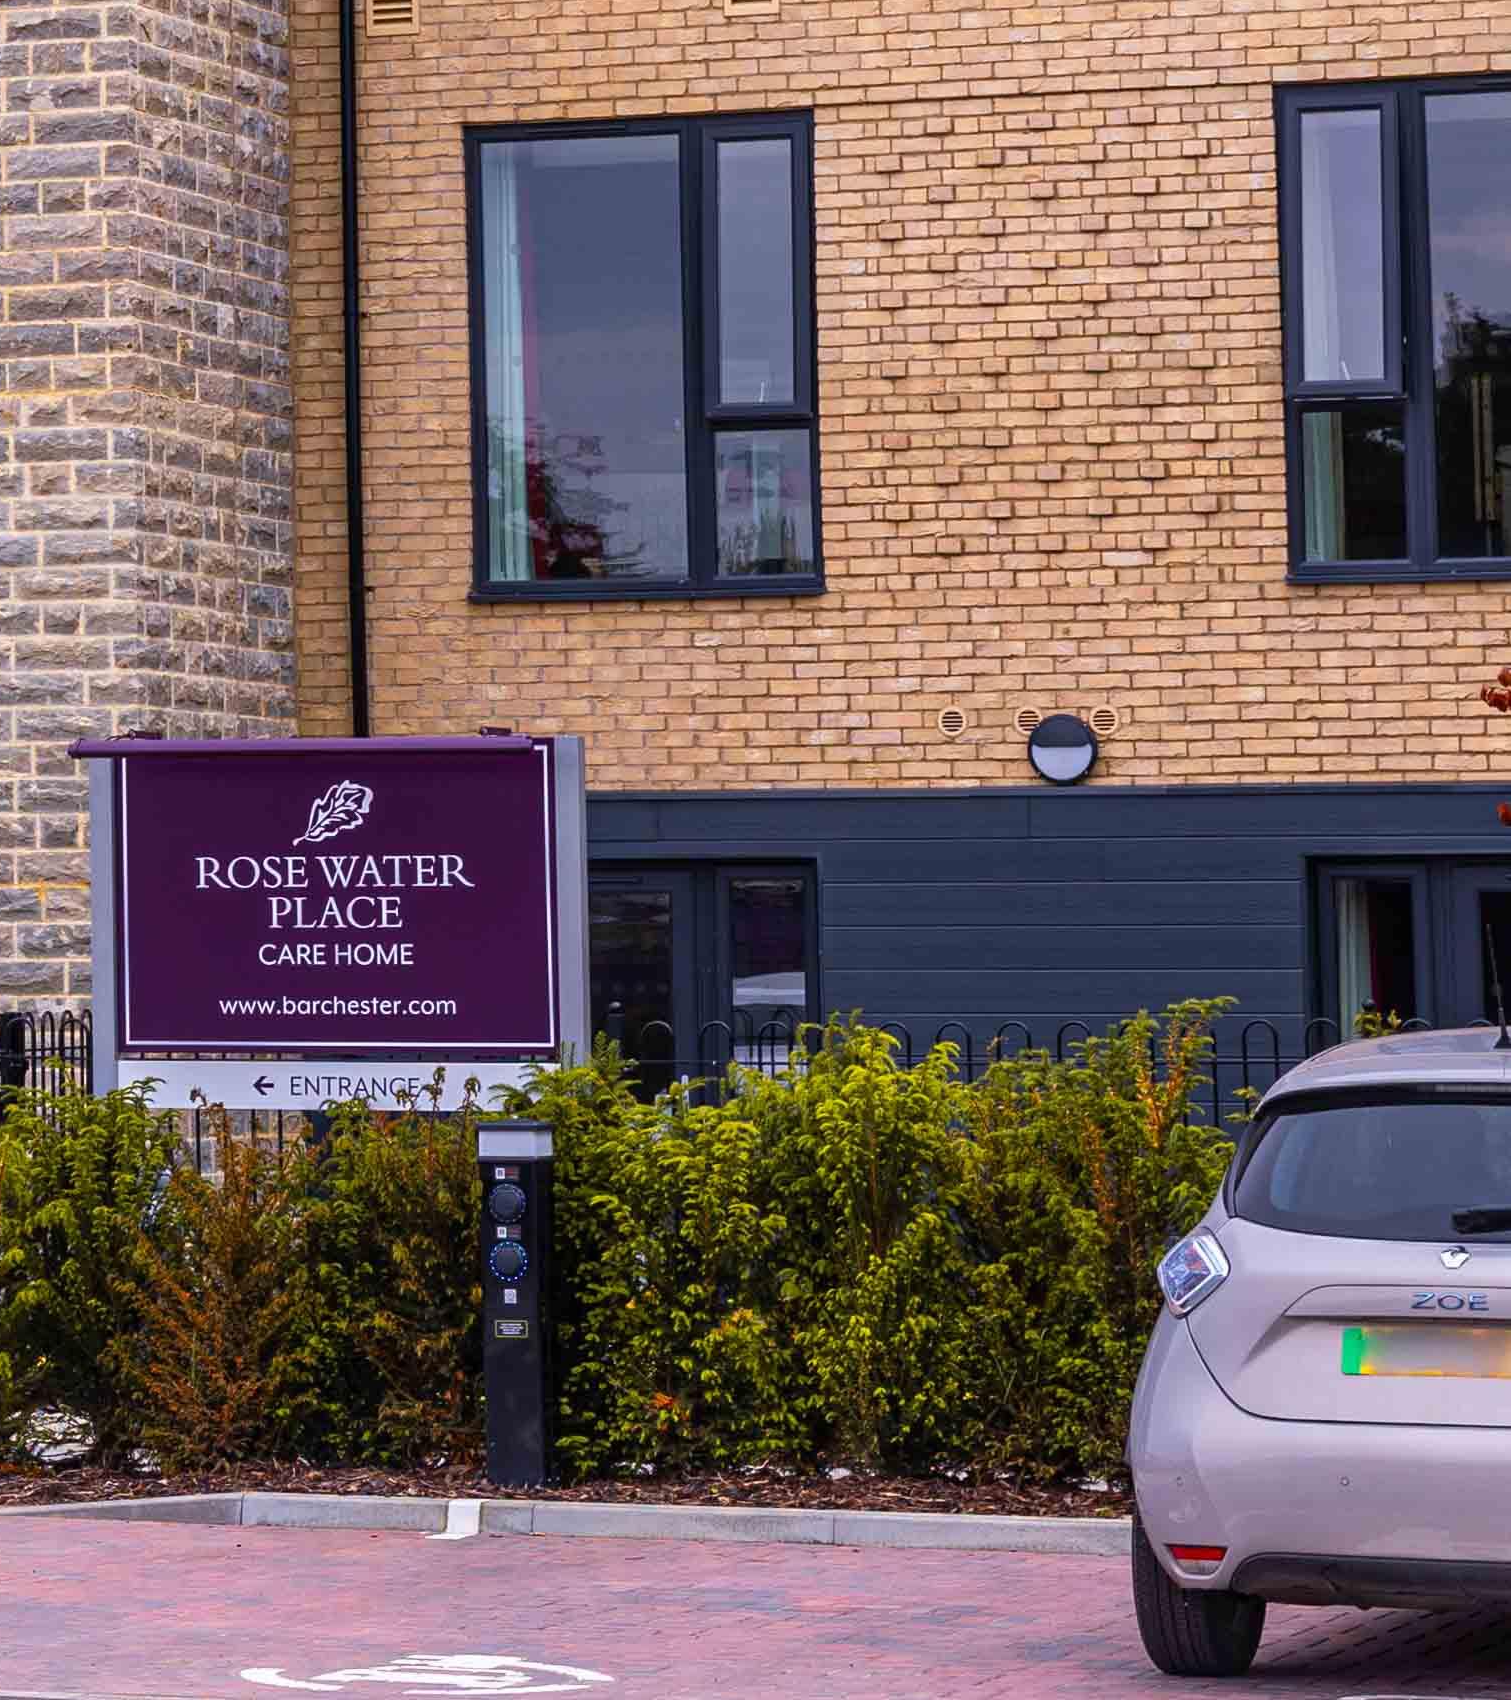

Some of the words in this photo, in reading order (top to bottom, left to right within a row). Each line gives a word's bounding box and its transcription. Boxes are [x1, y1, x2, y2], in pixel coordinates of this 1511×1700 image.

[194, 855, 310, 890] ROSE
[316, 854, 476, 889] WATER
[267, 895, 404, 930] PLACE
[258, 942, 326, 966] CARE
[334, 942, 415, 966] HOME
[219, 995, 457, 1017] www.barchester.com
[290, 1075, 421, 1097] ENTRANCE
[1409, 1291, 1490, 1312] ZOE
